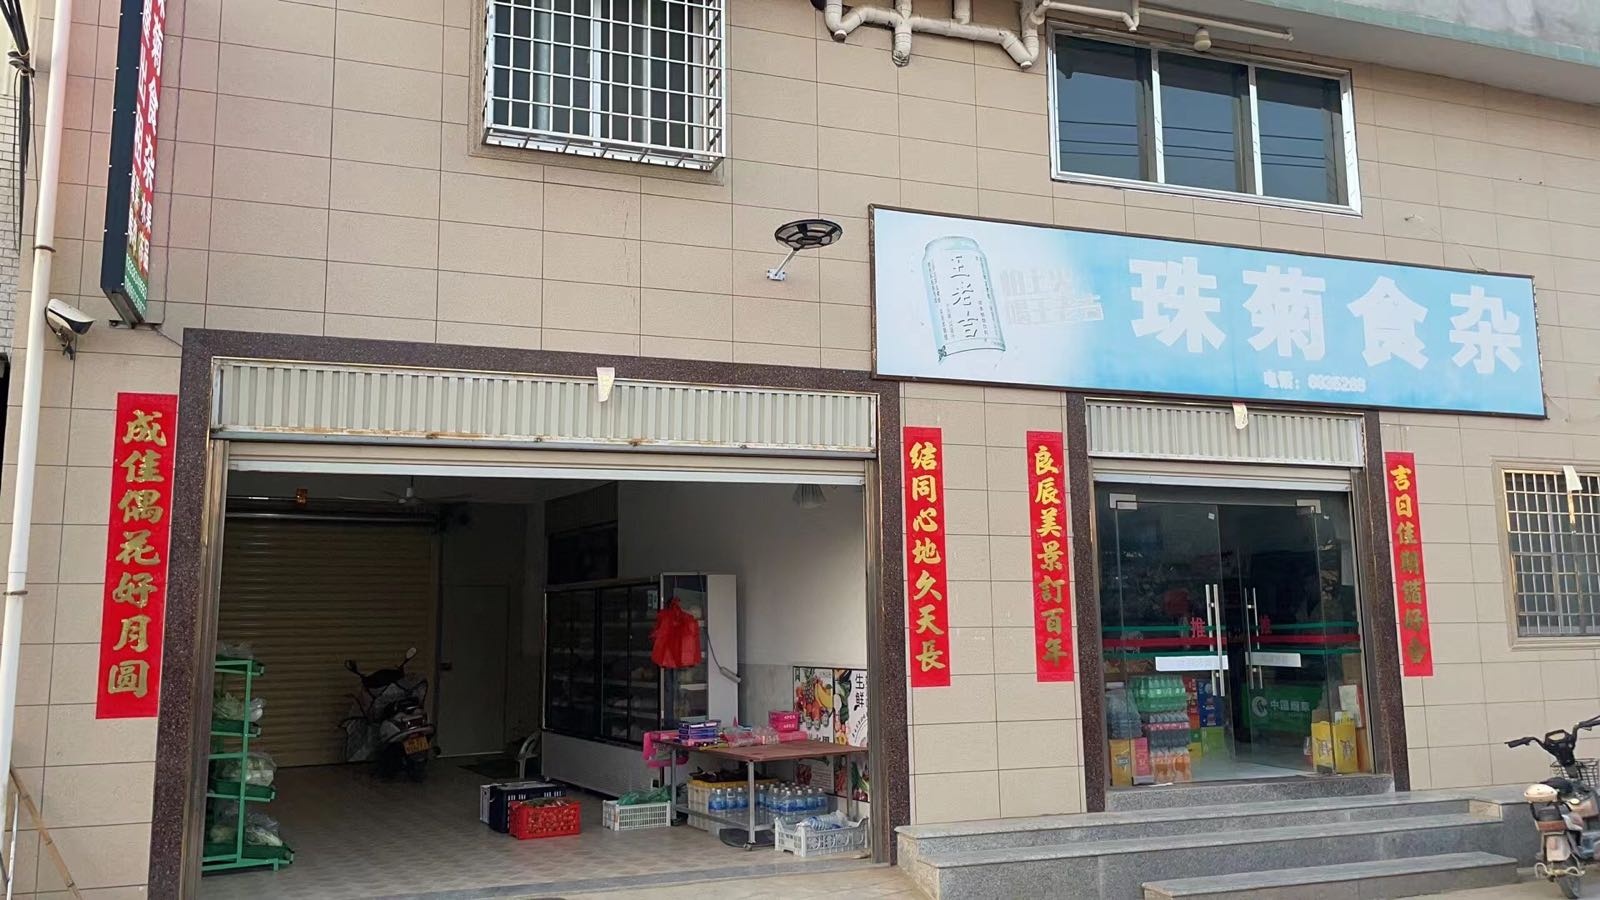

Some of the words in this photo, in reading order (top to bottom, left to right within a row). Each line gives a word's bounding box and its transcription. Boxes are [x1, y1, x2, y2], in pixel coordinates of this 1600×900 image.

[1128, 255, 1522, 375] 珠菊食杂
[107, 409, 168, 699] 成佳偶花好月圓
[1034, 445, 1069, 668] 良辰美景訂百年
[1190, 616, 1206, 638] 推
